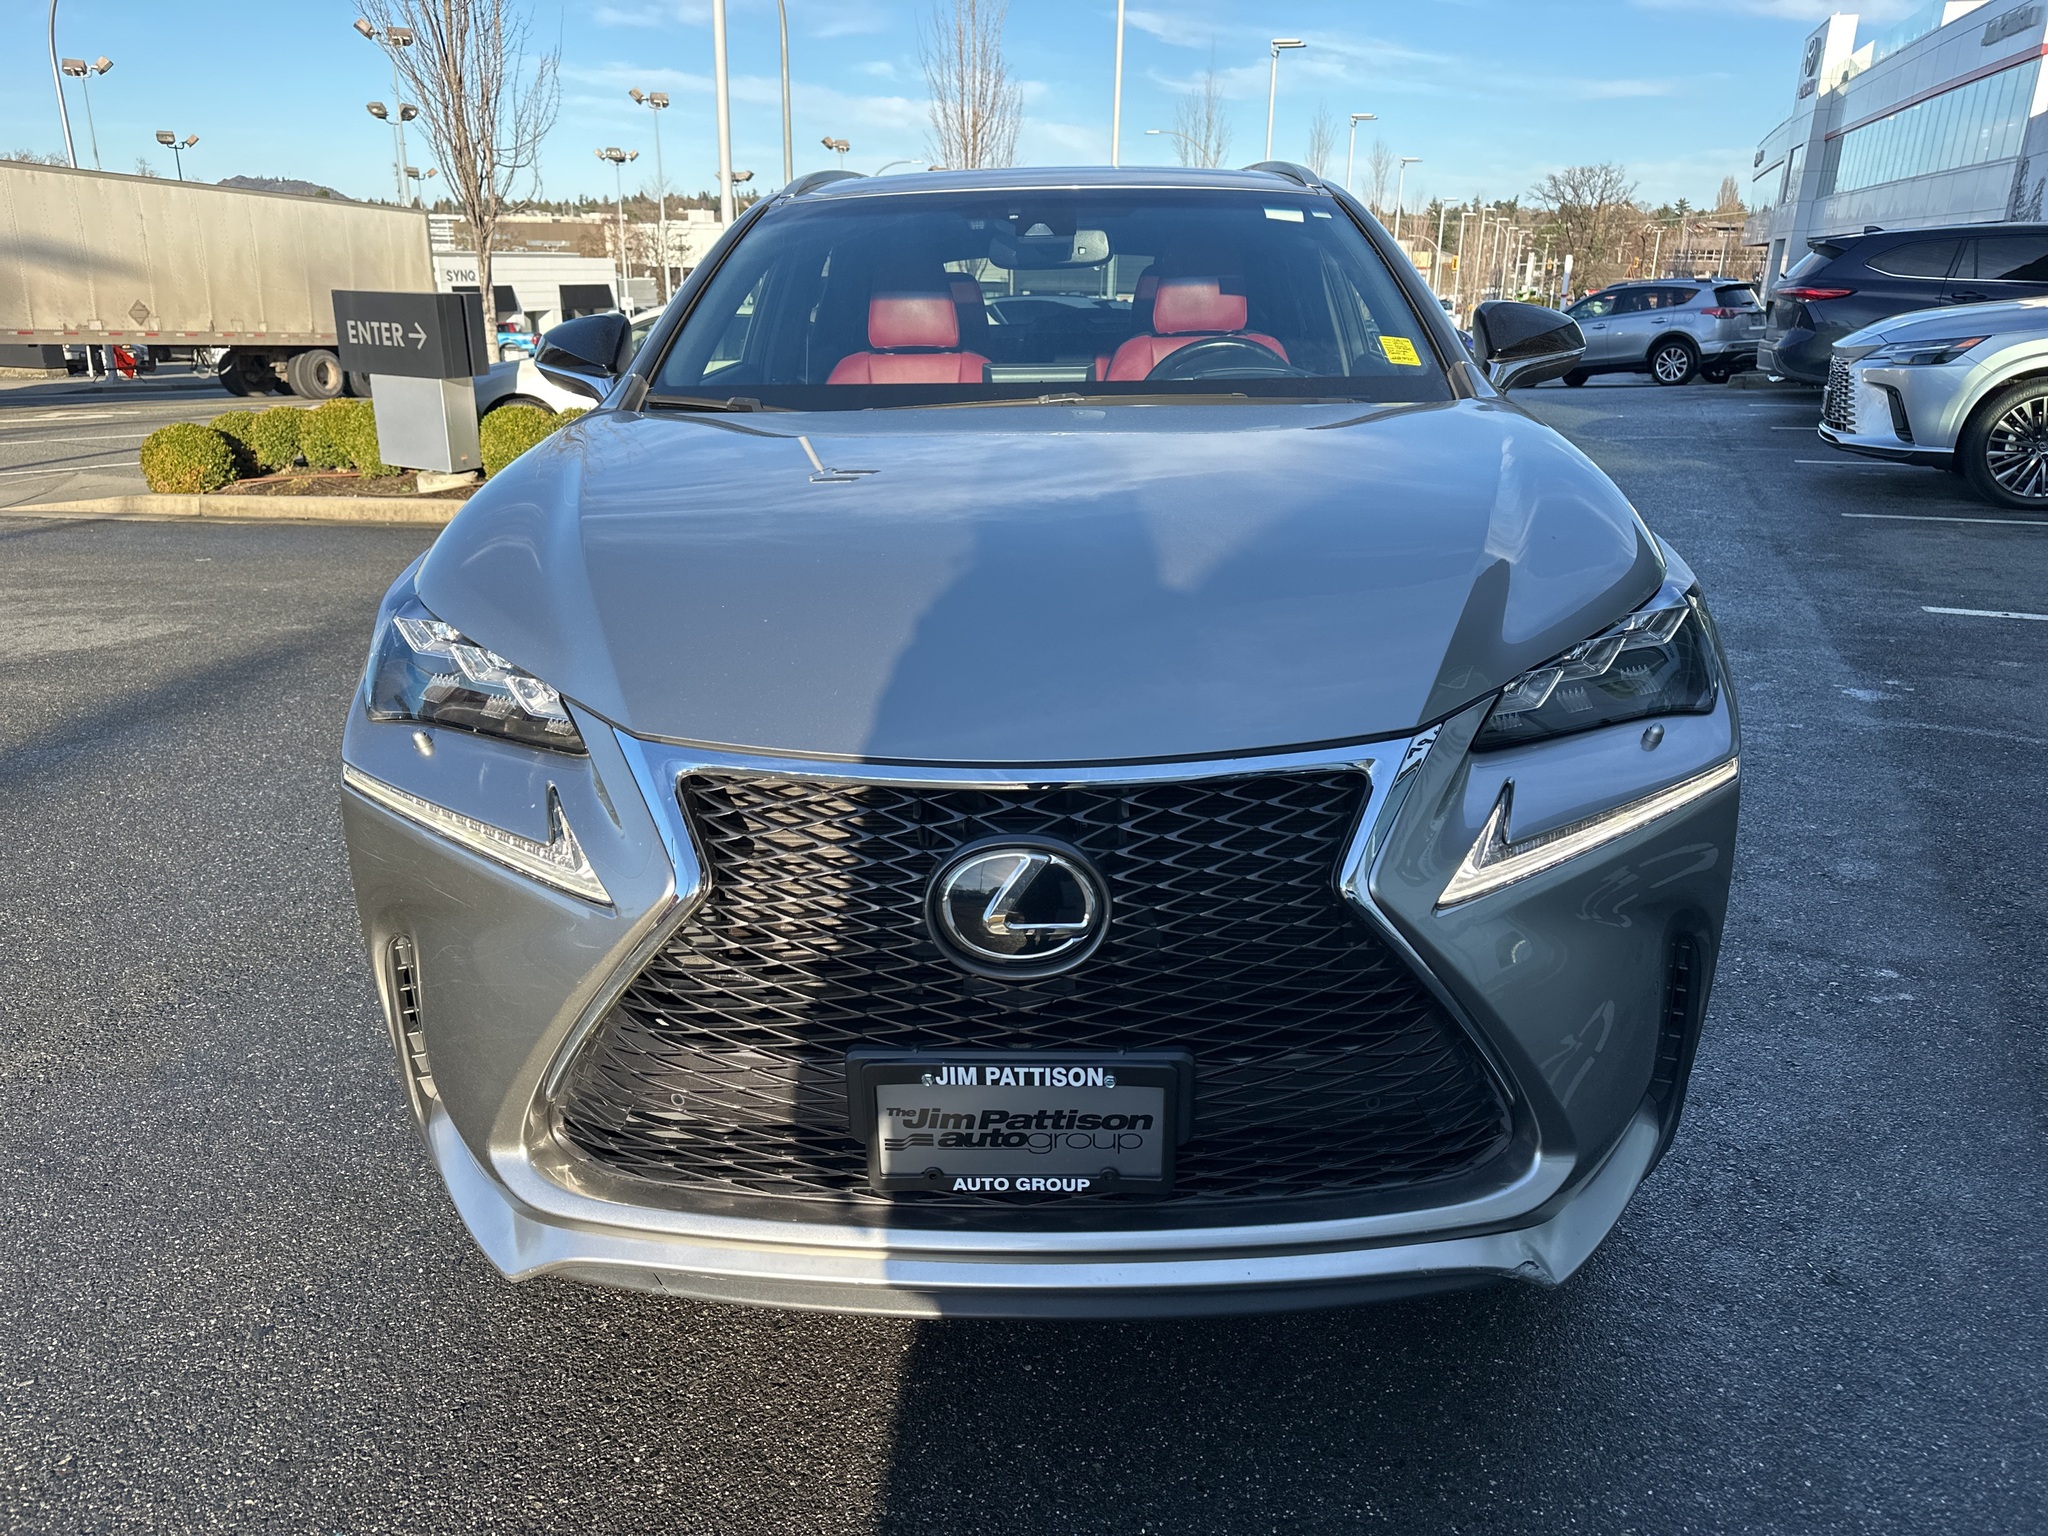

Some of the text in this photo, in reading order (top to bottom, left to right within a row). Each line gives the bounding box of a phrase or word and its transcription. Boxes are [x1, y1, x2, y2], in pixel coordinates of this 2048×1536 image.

[446, 270, 476, 282] SYNQ
[346, 320, 405, 347] ENTER
[935, 1066, 1104, 1087] JIM PATTISON
[886, 1107, 917, 1118] The
[952, 1177, 1091, 1192] AUTO GROUP
